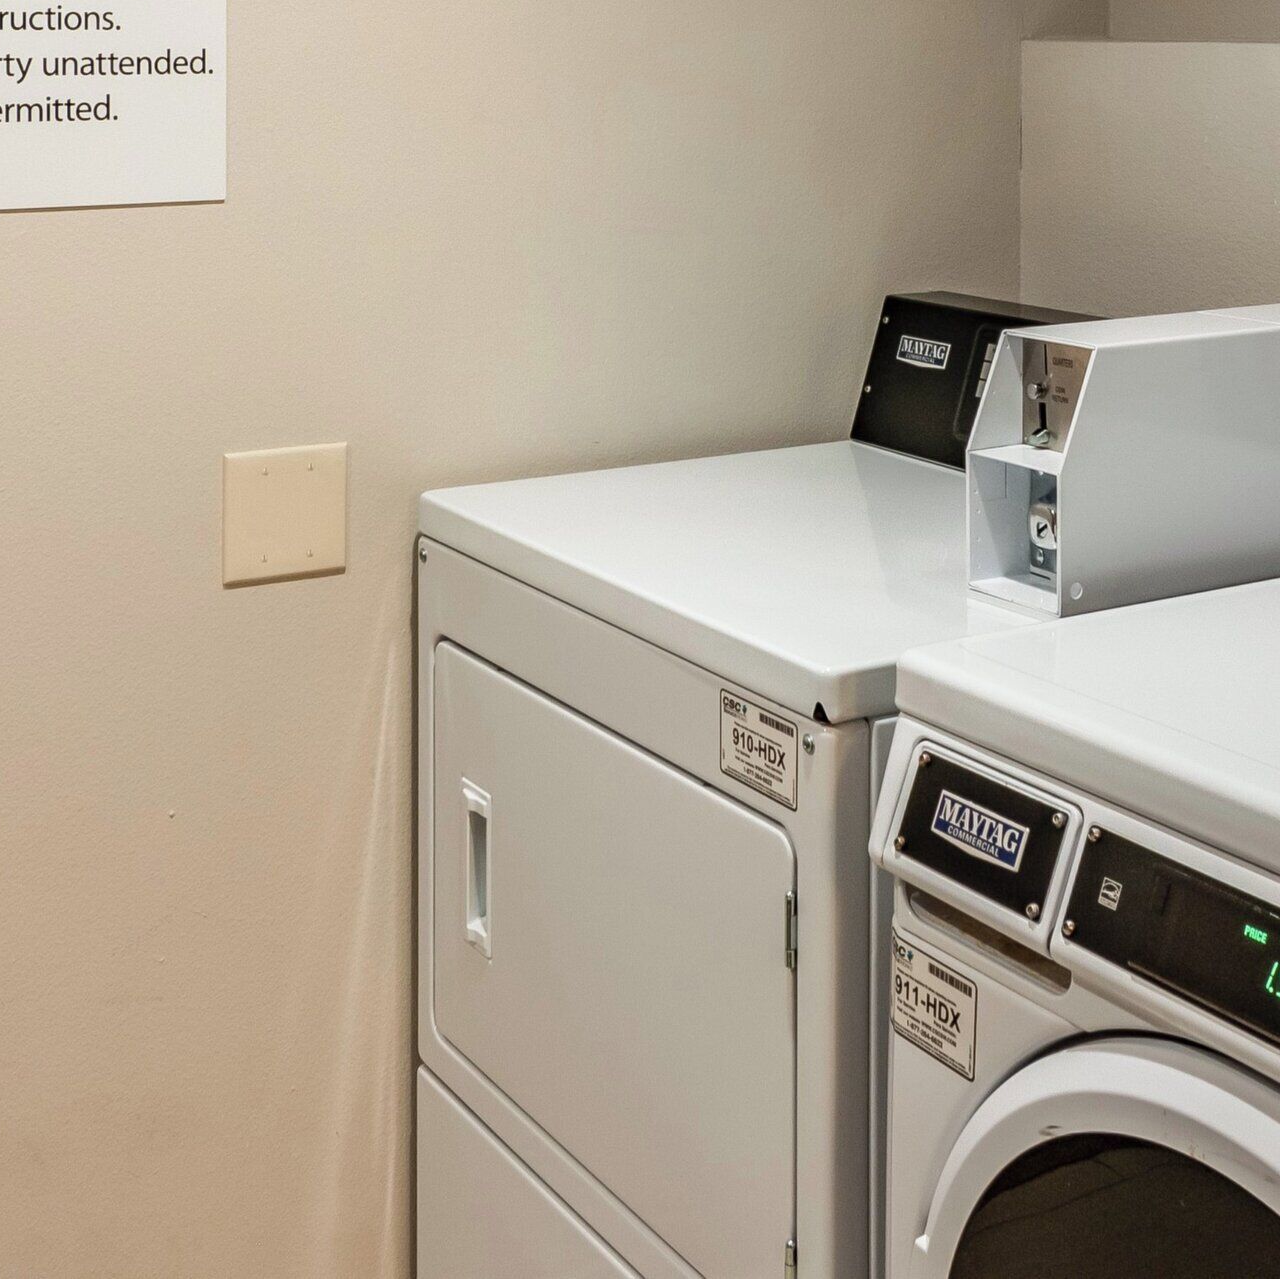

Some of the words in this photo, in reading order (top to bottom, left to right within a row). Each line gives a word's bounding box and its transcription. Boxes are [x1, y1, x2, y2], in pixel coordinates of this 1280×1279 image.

[42, 47, 213, 76] unattended.
[901, 339, 946, 360] MAYTAG
[722, 696, 742, 713] CSC
[732, 727, 787, 771] 910-HDX
[938, 796, 1020, 854] MAYTAG
[947, 825, 1000, 858] COMMERCIAL
[1243, 924, 1268, 945] PRICE
[894, 973, 961, 1033] 911-HDX
